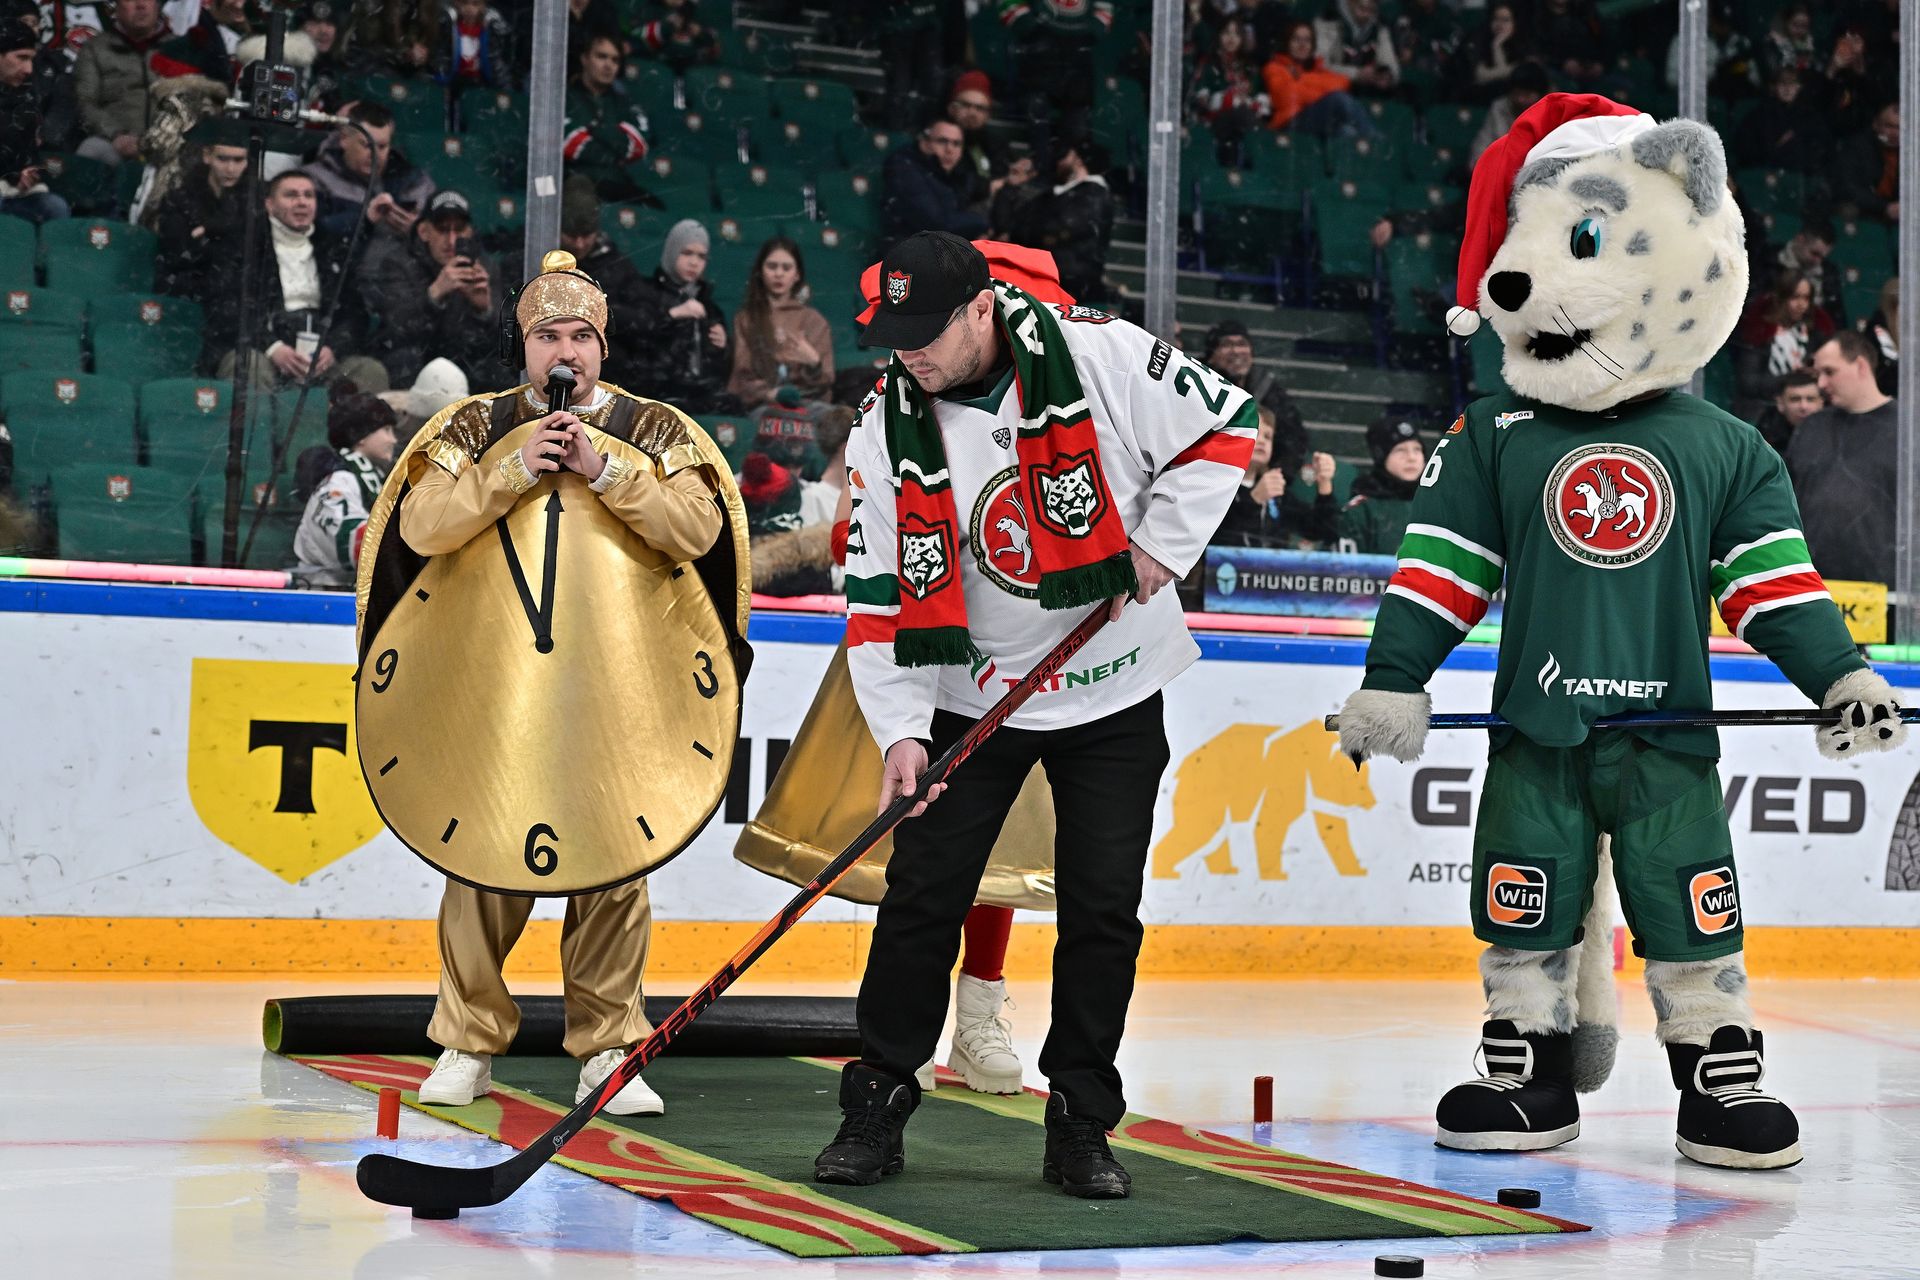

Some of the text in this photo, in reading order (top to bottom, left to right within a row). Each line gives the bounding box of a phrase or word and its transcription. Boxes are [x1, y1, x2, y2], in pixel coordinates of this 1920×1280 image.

[1240, 572, 1389, 595] THUNDEROBOT
[371, 648, 399, 694] 9
[692, 650, 719, 699] 3
[1002, 646, 1141, 693] TTNEFT
[1562, 678, 1668, 698] TATNEFT
[248, 719, 347, 814] T
[524, 823, 559, 876] 6
[1500, 885, 1541, 907] Win
[1704, 890, 1736, 912] Win
